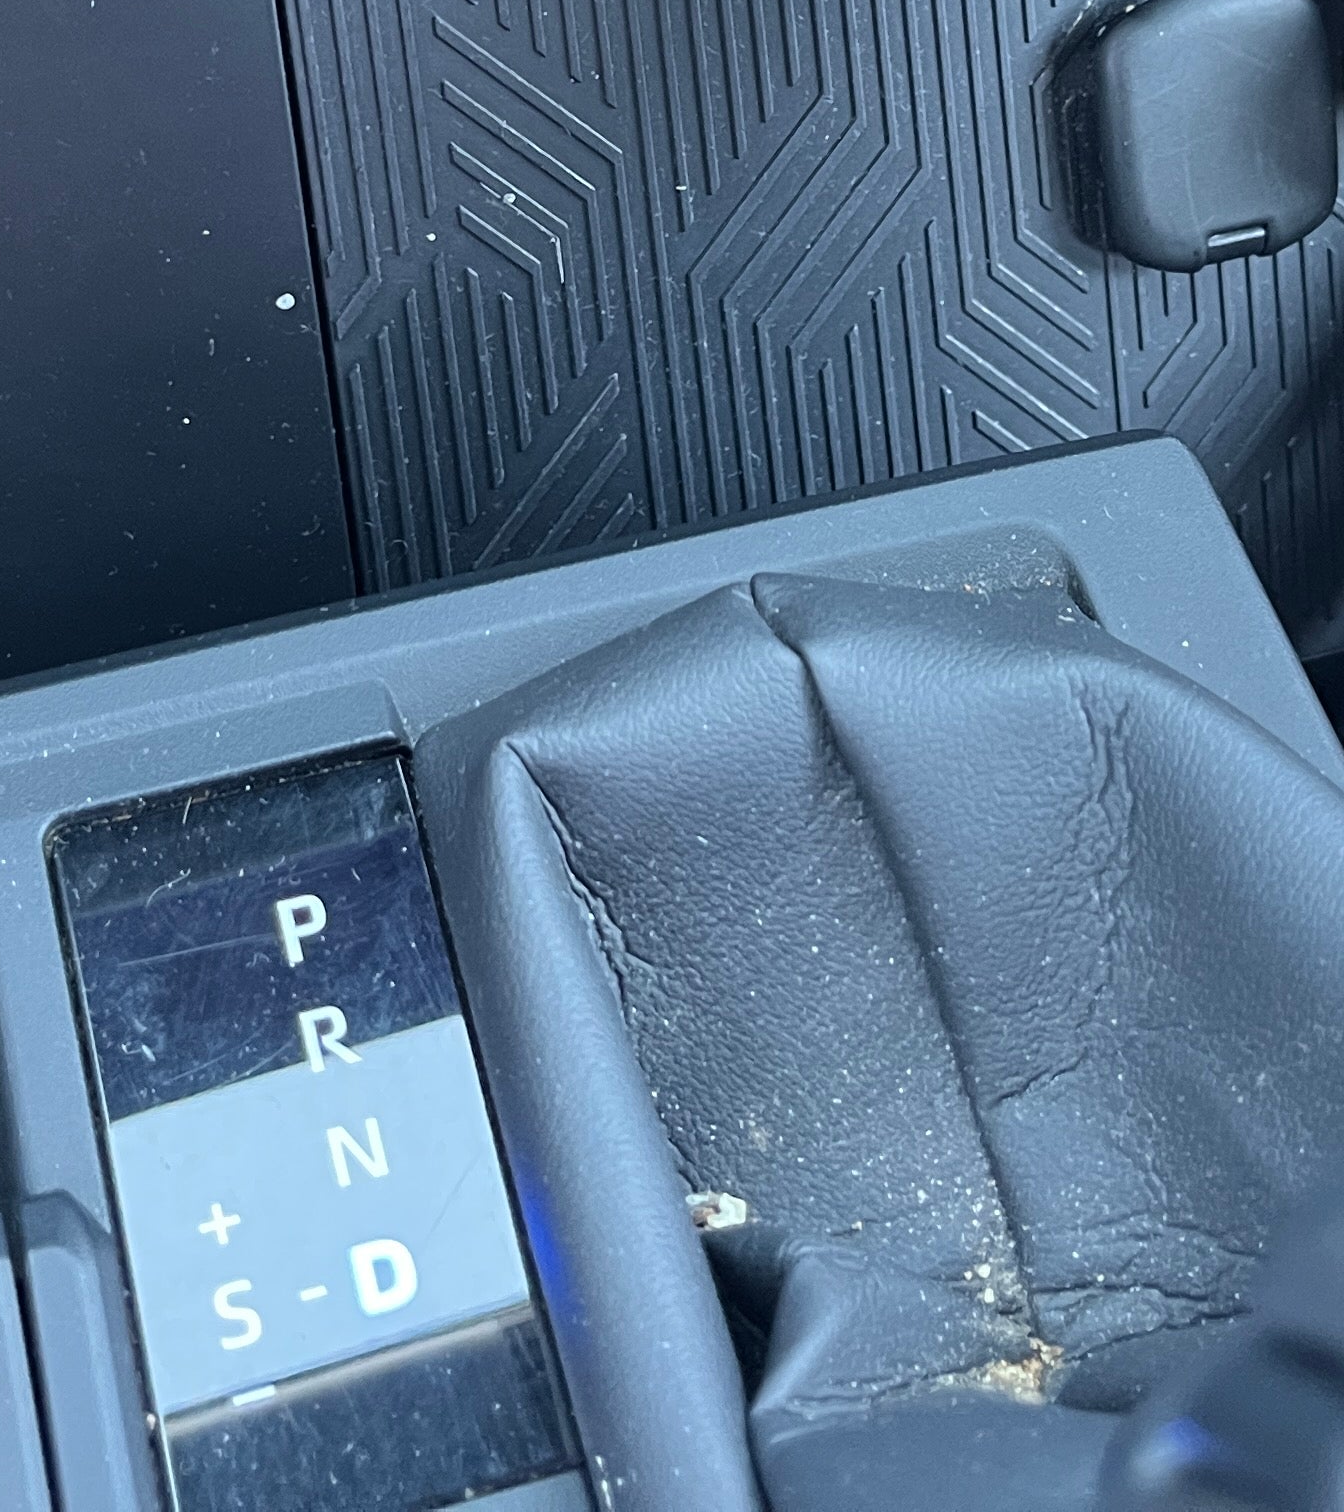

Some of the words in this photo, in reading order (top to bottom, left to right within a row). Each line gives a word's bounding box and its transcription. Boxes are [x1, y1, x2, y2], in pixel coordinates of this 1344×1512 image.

[274, 893, 327, 968] P
[298, 1005, 362, 1073] R
[325, 1116, 390, 1189] N
[212, 1279, 263, 1351] S
[348, 1238, 419, 1317] D
